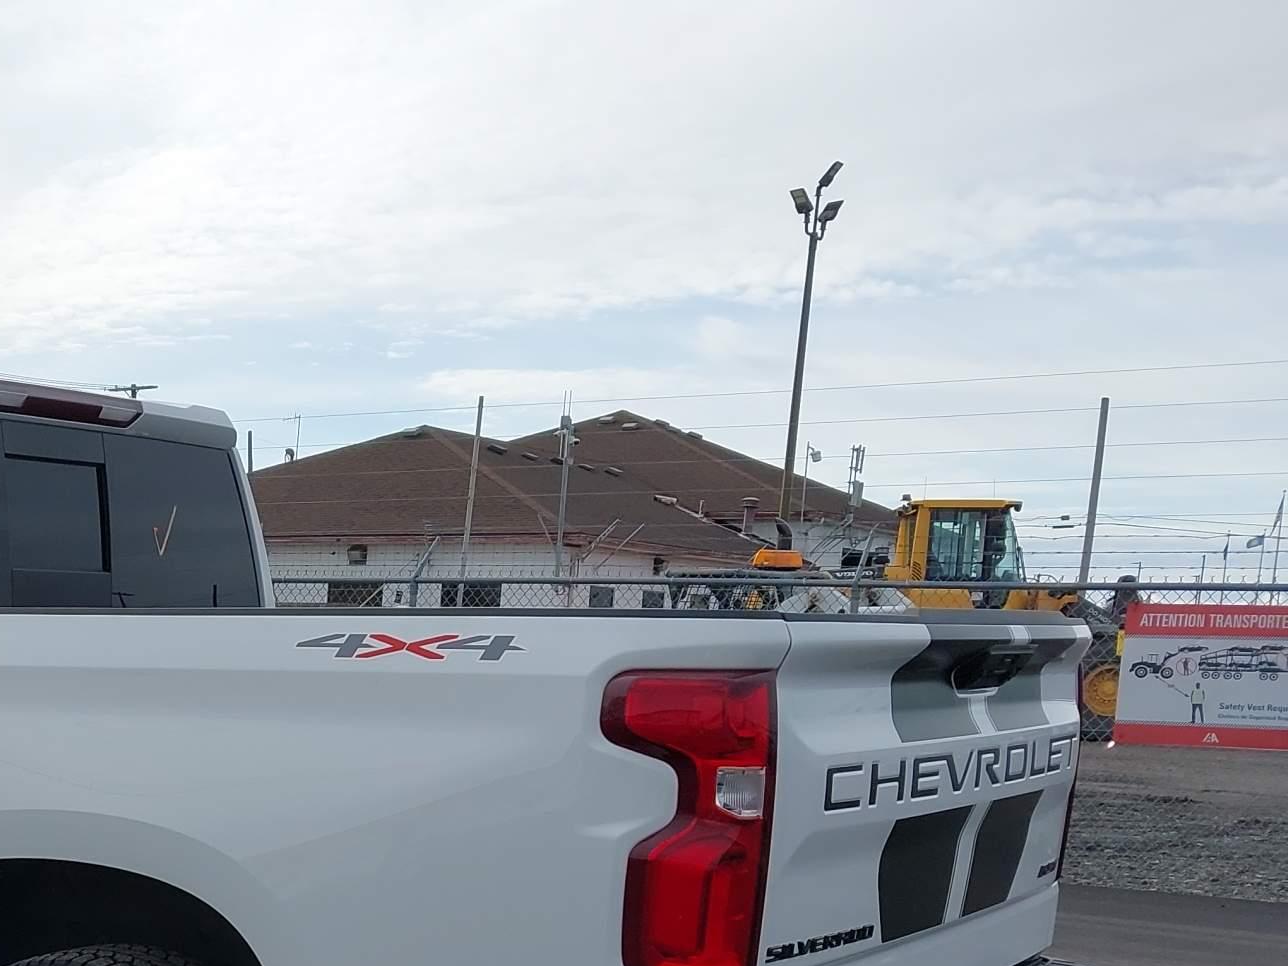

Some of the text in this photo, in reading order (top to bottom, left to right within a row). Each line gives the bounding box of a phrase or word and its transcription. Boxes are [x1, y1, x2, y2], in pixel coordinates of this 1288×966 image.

[1139, 613, 1205, 628] ATTENTION
[1218, 702, 1245, 712] Safety
[1247, 703, 1265, 711] Vest
[824, 735, 1079, 815] CHEVROLET
[764, 924, 875, 964] SILVERADO
